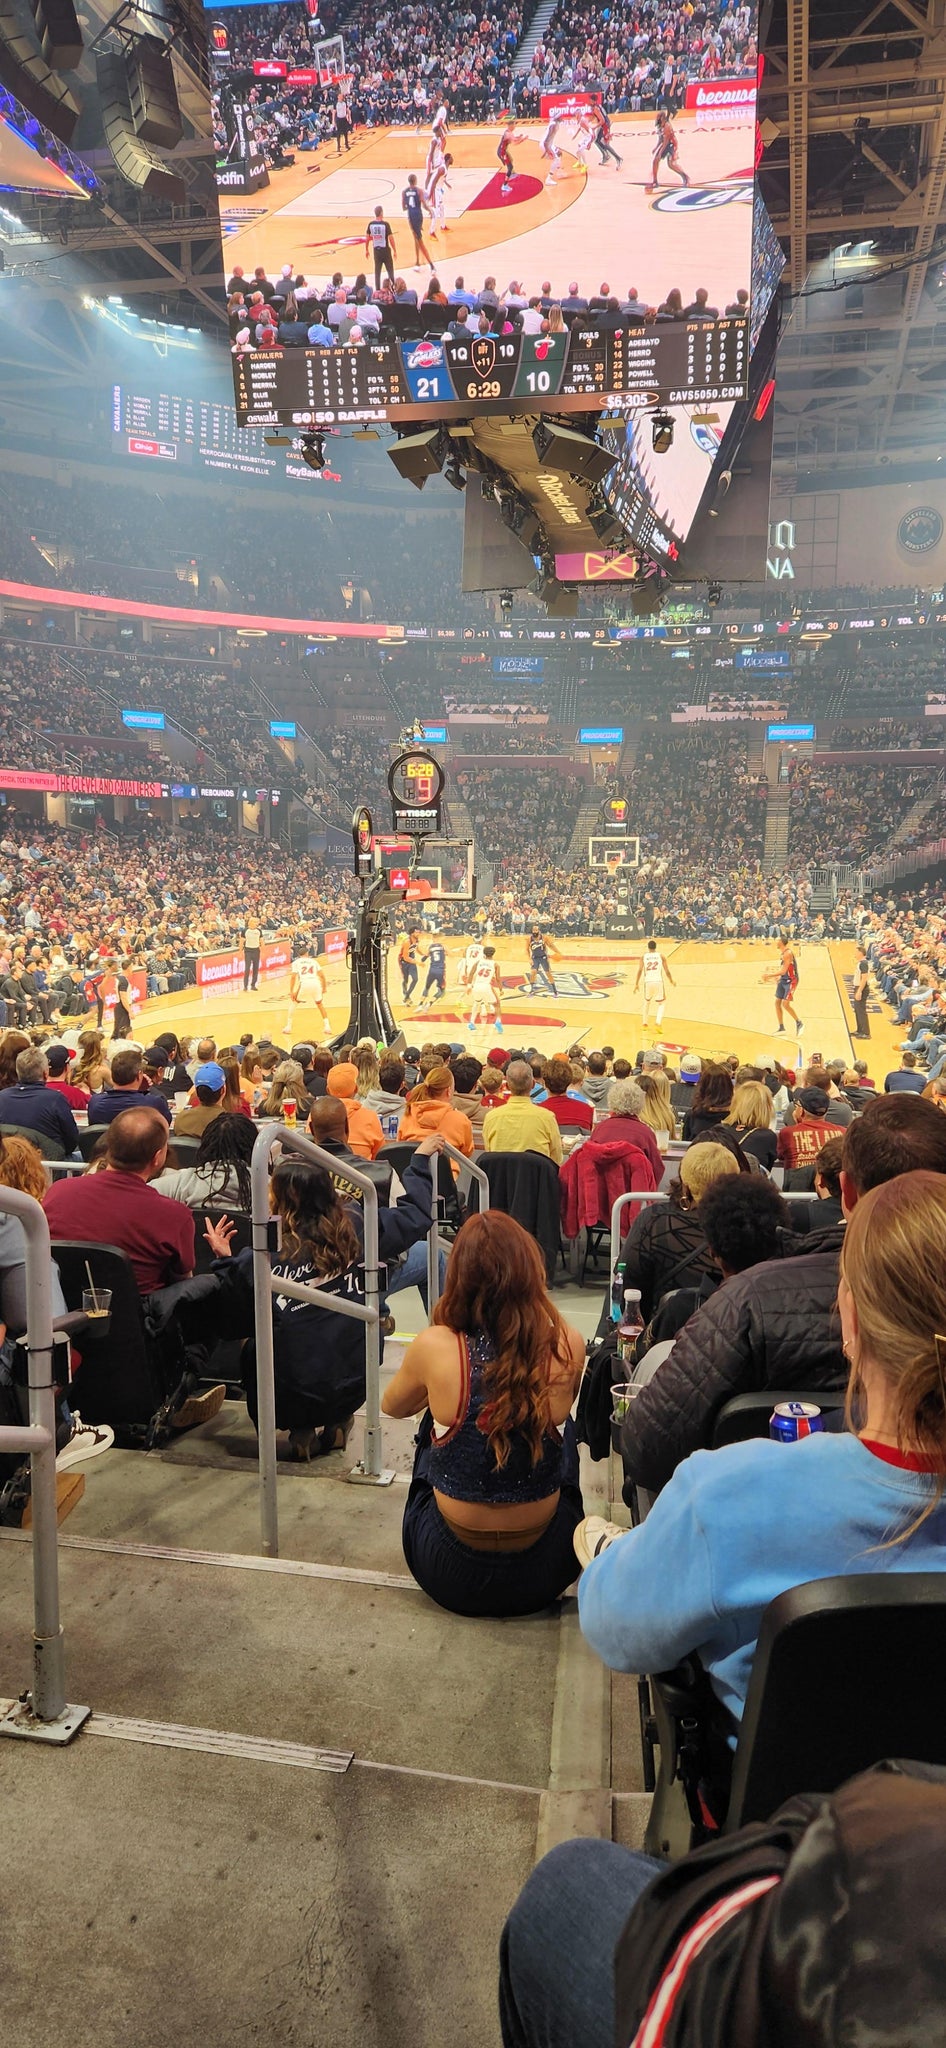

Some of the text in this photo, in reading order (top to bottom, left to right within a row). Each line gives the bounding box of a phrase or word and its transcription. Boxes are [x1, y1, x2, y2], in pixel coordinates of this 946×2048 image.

[696, 88, 757, 106] because
[549, 106, 570, 116] giant
[692, 125, 752, 133] Aren
[217, 171, 244, 185] edfin
[579, 332, 599, 340] FOULS
[628, 328, 646, 336] HEAT
[586, 339, 592, 348] 3
[628, 338, 660, 346] ADEBAYO
[688, 334, 694, 342] 0
[720, 332, 726, 340] 0
[499, 344, 514, 358] 10
[688, 345, 694, 353] 2
[706, 344, 710, 352] 1
[720, 342, 724, 350] 1
[737, 341, 743, 349] 0
[250, 352, 283, 360] CAVALIERS
[377, 353, 383, 361] 2
[450, 347, 468, 361] 1Q
[306, 360, 312, 368] 3
[322, 359, 328, 367] 0
[336, 358, 342, 366] 3
[476, 357, 490, 366] +11
[594, 363, 604, 371] 30
[628, 360, 656, 368] WIGGINS
[706, 354, 712, 362] 0
[251, 372, 276, 380] MOBLEY
[628, 370, 654, 378] POWELL
[688, 366, 694, 374] 5
[706, 364, 711, 372] 0
[737, 362, 742, 370] 2
[417, 378, 439, 397] 21
[527, 371, 550, 392] 10
[628, 380, 659, 388] MITCHELL
[688, 376, 694, 384] 0
[467, 381, 501, 398] 6:29
[564, 386, 577, 394] TOL
[670, 386, 743, 401] CAVS5050.COM
[324, 398, 329, 406] 2
[607, 394, 648, 409] $6,305
[247, 411, 278, 423] oswald
[337, 410, 387, 421] RAFFLE
[286, 465, 322, 479] KeyBank
[766, 557, 795, 580] NA
[560, 631, 566, 639] 2
[644, 628, 654, 637] 21
[753, 624, 763, 633] 10
[827, 622, 838, 630] 30
[850, 620, 874, 628] FOULS
[880, 618, 887, 627] 3
[919, 616, 925, 624] 6
[408, 763, 434, 777] 6:28
[56, 774, 70, 792] THE
[72, 776, 114, 795] CLEVELAND
[115, 780, 155, 797] CAVALIERS
[419, 778, 431, 800] 9
[201, 789, 234, 797] REBOUNDS
[328, 845, 355, 853] LECO
[433, 951, 440, 961] 5
[301, 966, 314, 975] 24
[646, 961, 658, 971] 22
[478, 968, 491, 978] 45
[793, 1130, 816, 1152] THE
[271, 1262, 313, 1280] Cleve
